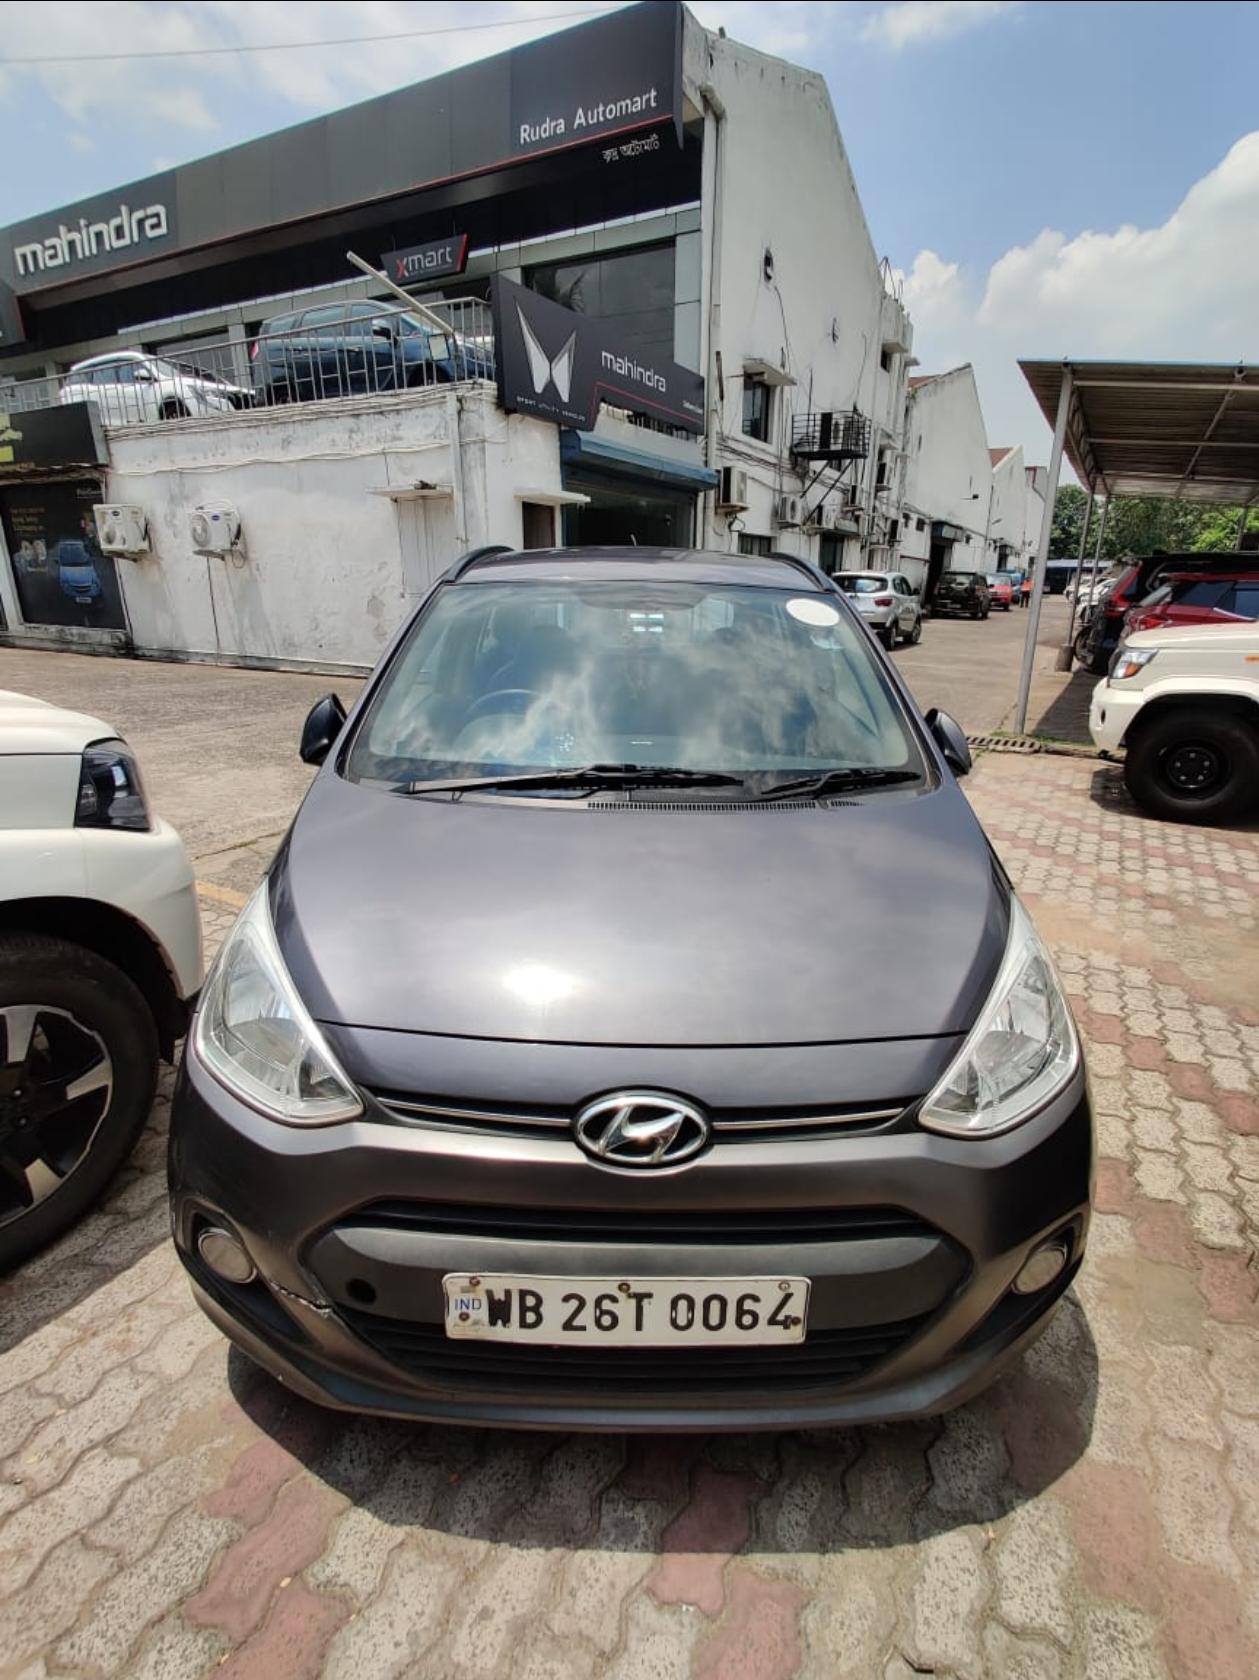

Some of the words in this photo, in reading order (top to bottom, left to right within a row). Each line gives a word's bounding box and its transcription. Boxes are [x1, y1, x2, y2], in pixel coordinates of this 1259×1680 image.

[520, 117, 566, 145] Rudra
[573, 87, 657, 130] Automart
[14, 203, 168, 276] mahindra
[601, 350, 666, 393] mahindra
[454, 1297, 482, 1311] IND
[486, 1287, 544, 1329] WB
[669, 1292, 795, 1332] 0064
